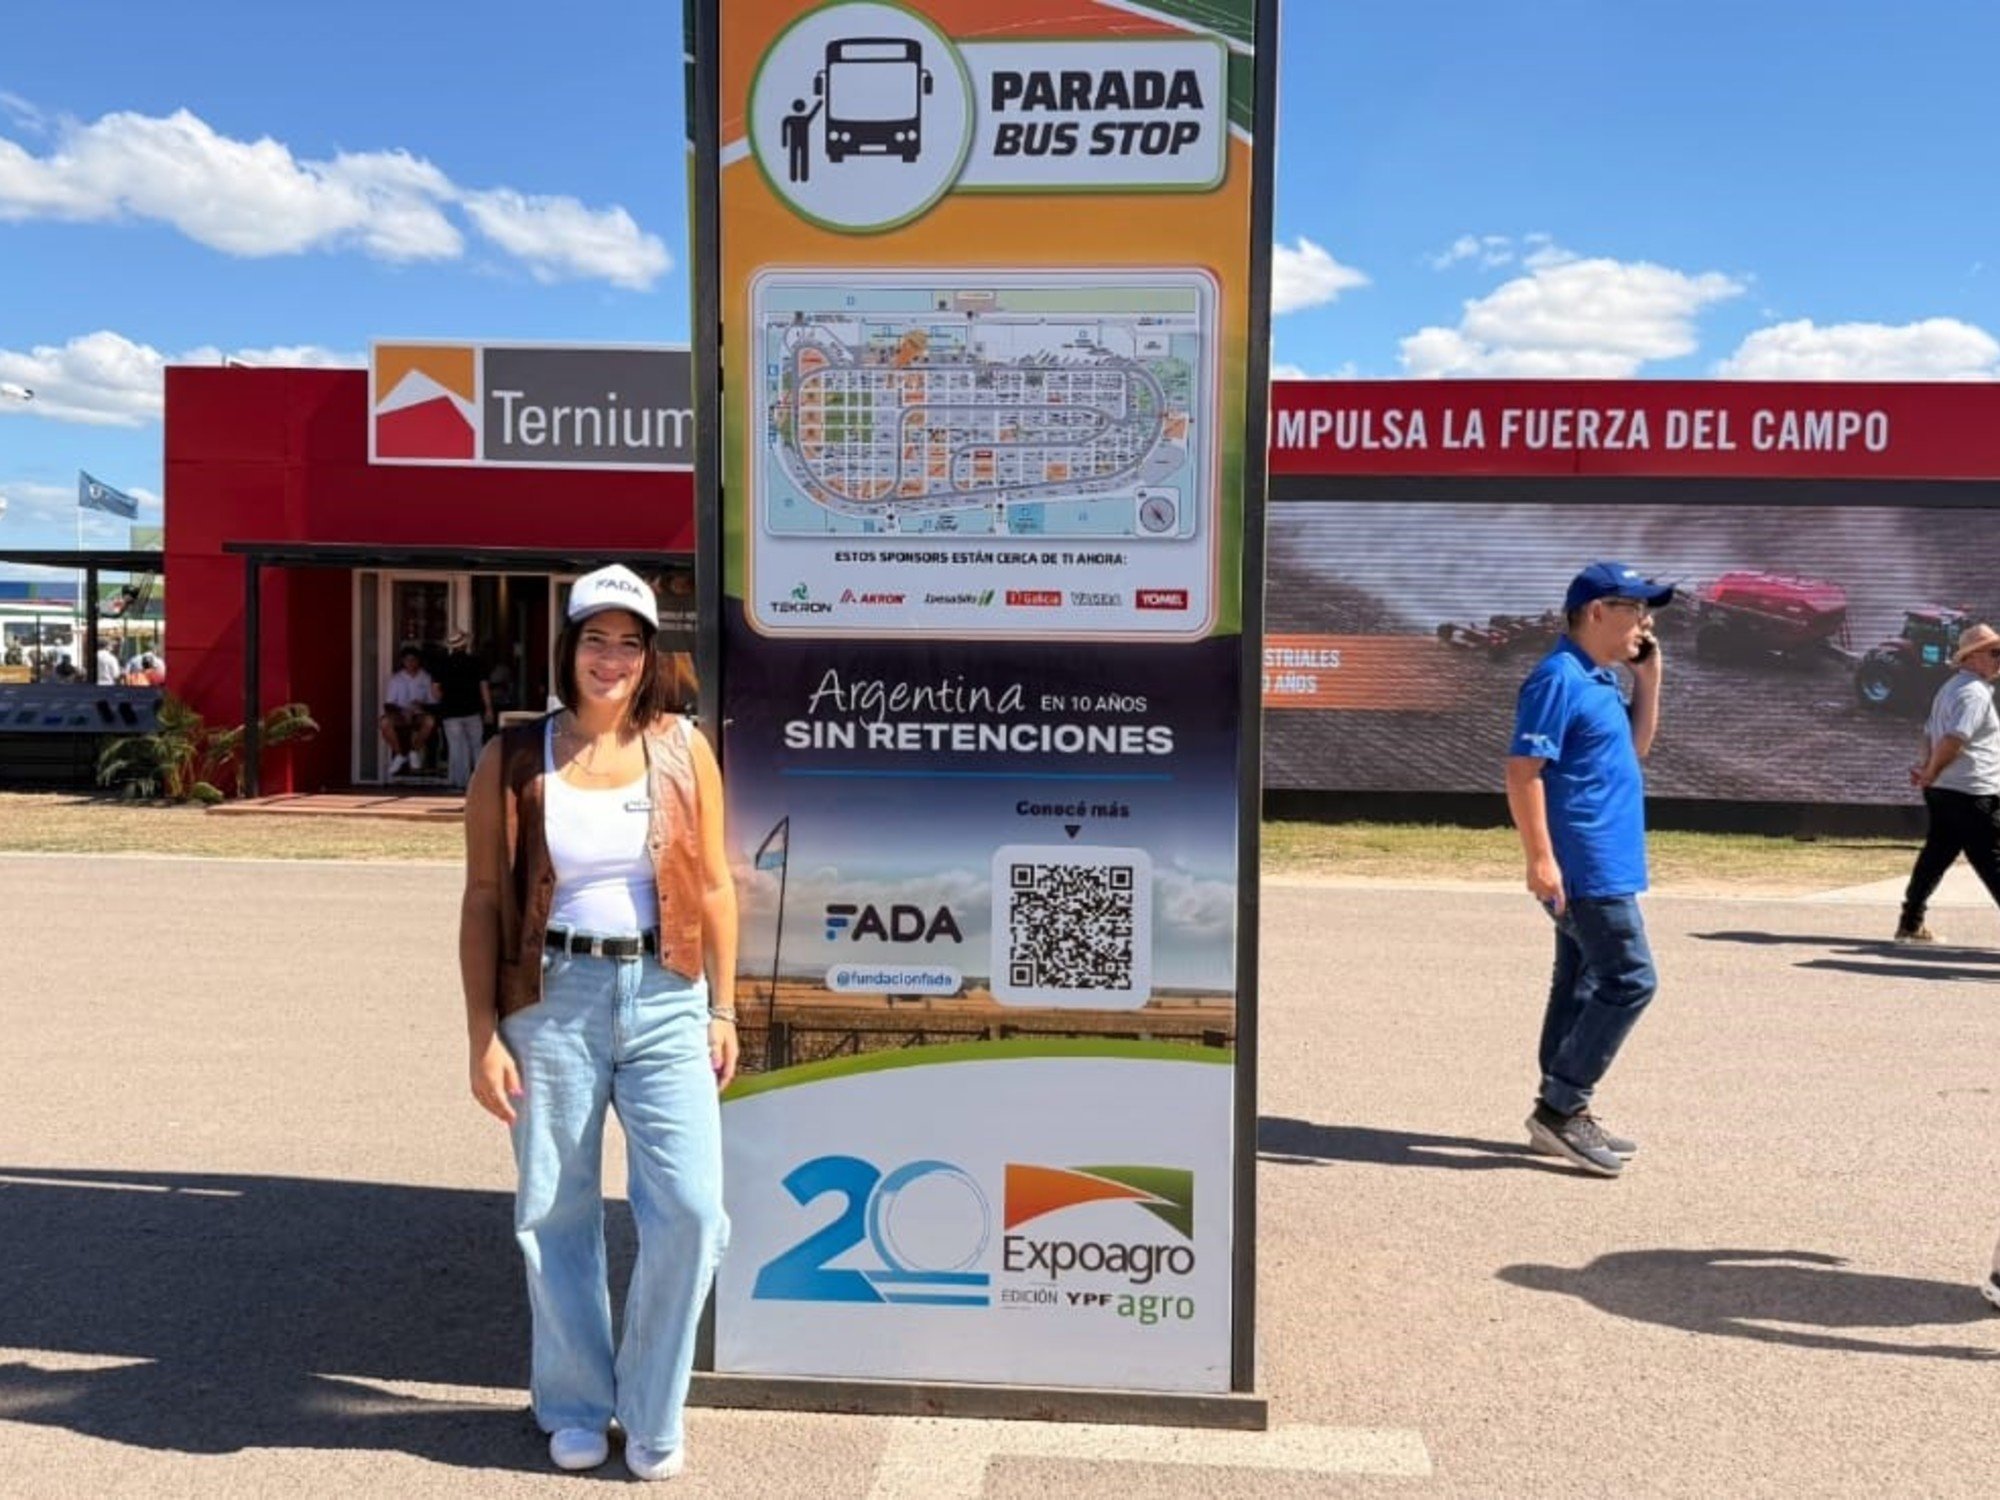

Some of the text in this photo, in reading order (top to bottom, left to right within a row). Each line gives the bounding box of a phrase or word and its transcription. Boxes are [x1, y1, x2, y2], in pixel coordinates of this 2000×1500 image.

[991, 69, 1204, 111] PARADA
[993, 121, 1201, 156] BUS STOP
[491, 389, 694, 448] Ternium
[1267, 409, 1889, 451] MPULSA LA FUERZA DEL CAMPO
[834, 549, 1128, 566] ESTOS SPONSORS ESTÁN CERCA DE TI AHORA:
[771, 601, 832, 613] TEKRON
[808, 668, 1148, 730] Argentina EN 10 AÑOS
[784, 720, 1174, 755] SIN RETENCIONES
[1016, 800, 1130, 817] Conocé más
[826, 904, 963, 944] FADA
[837, 970, 952, 987] @fundacionfada
[752, 1155, 990, 1306] 20
[1003, 1235, 1195, 1285] Expoagro
[1001, 1288, 1195, 1325] EDICIÓN YPF agro
